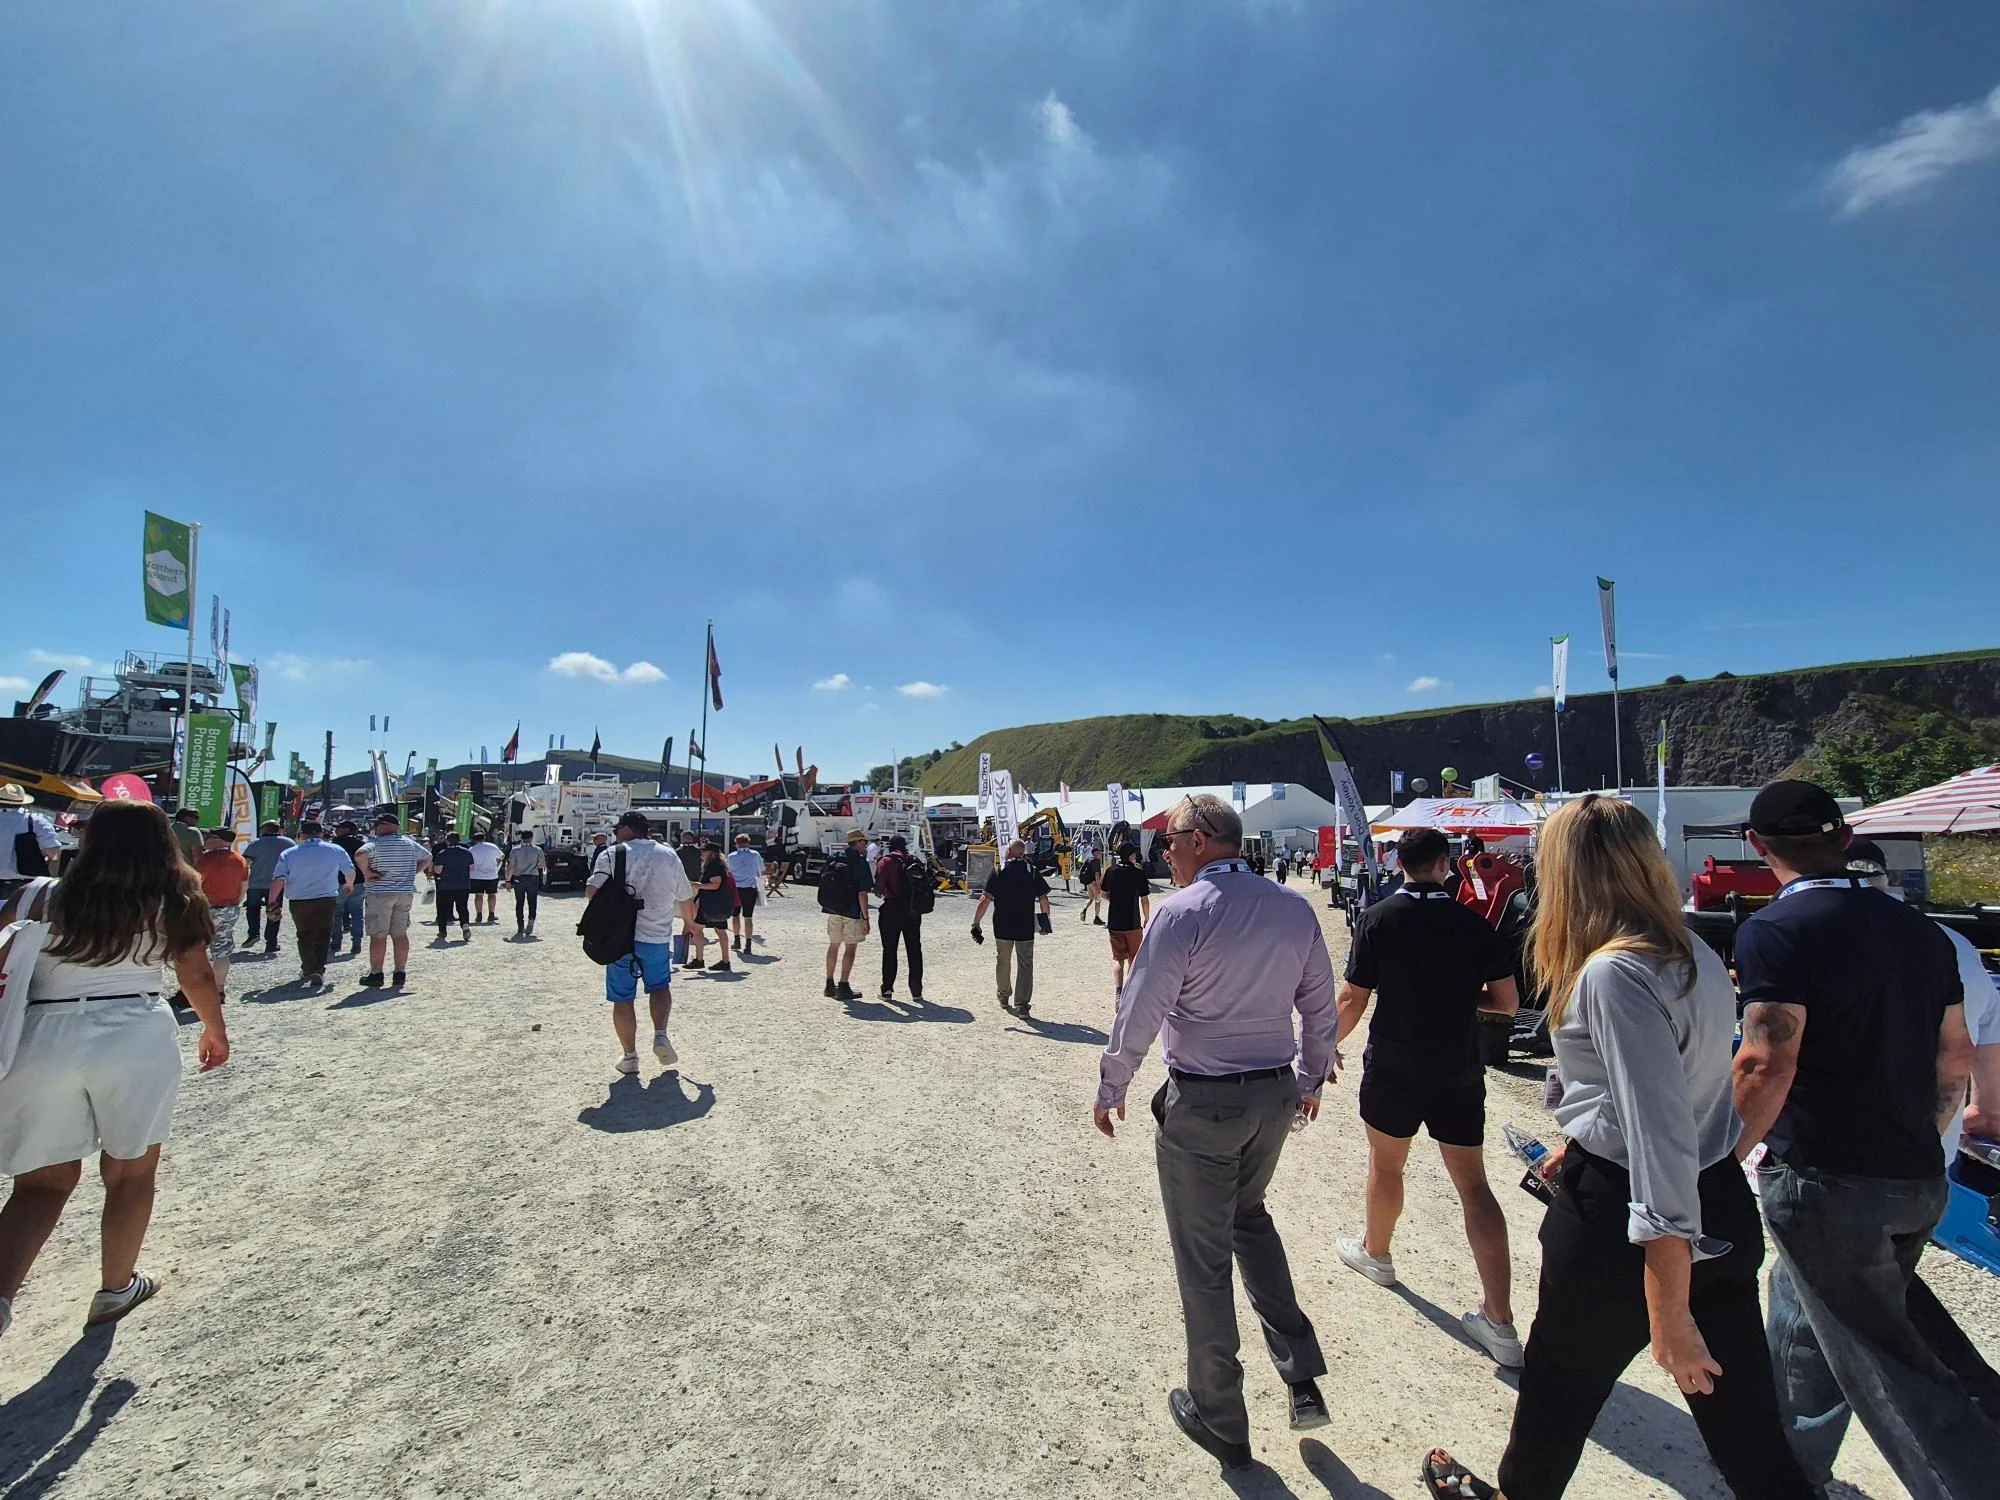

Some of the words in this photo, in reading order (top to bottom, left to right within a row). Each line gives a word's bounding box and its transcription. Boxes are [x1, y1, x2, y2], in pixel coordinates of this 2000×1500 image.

[187, 727, 208, 784] Processing
[205, 728, 220, 758] Bruce
[186, 786, 201, 811] Solu
[201, 760, 216, 807] Materials
[1340, 780, 1356, 812] Valley
[994, 776, 1010, 847] BROKK
[1112, 788, 1120, 820] OKK
[1353, 812, 1365, 836] Don
